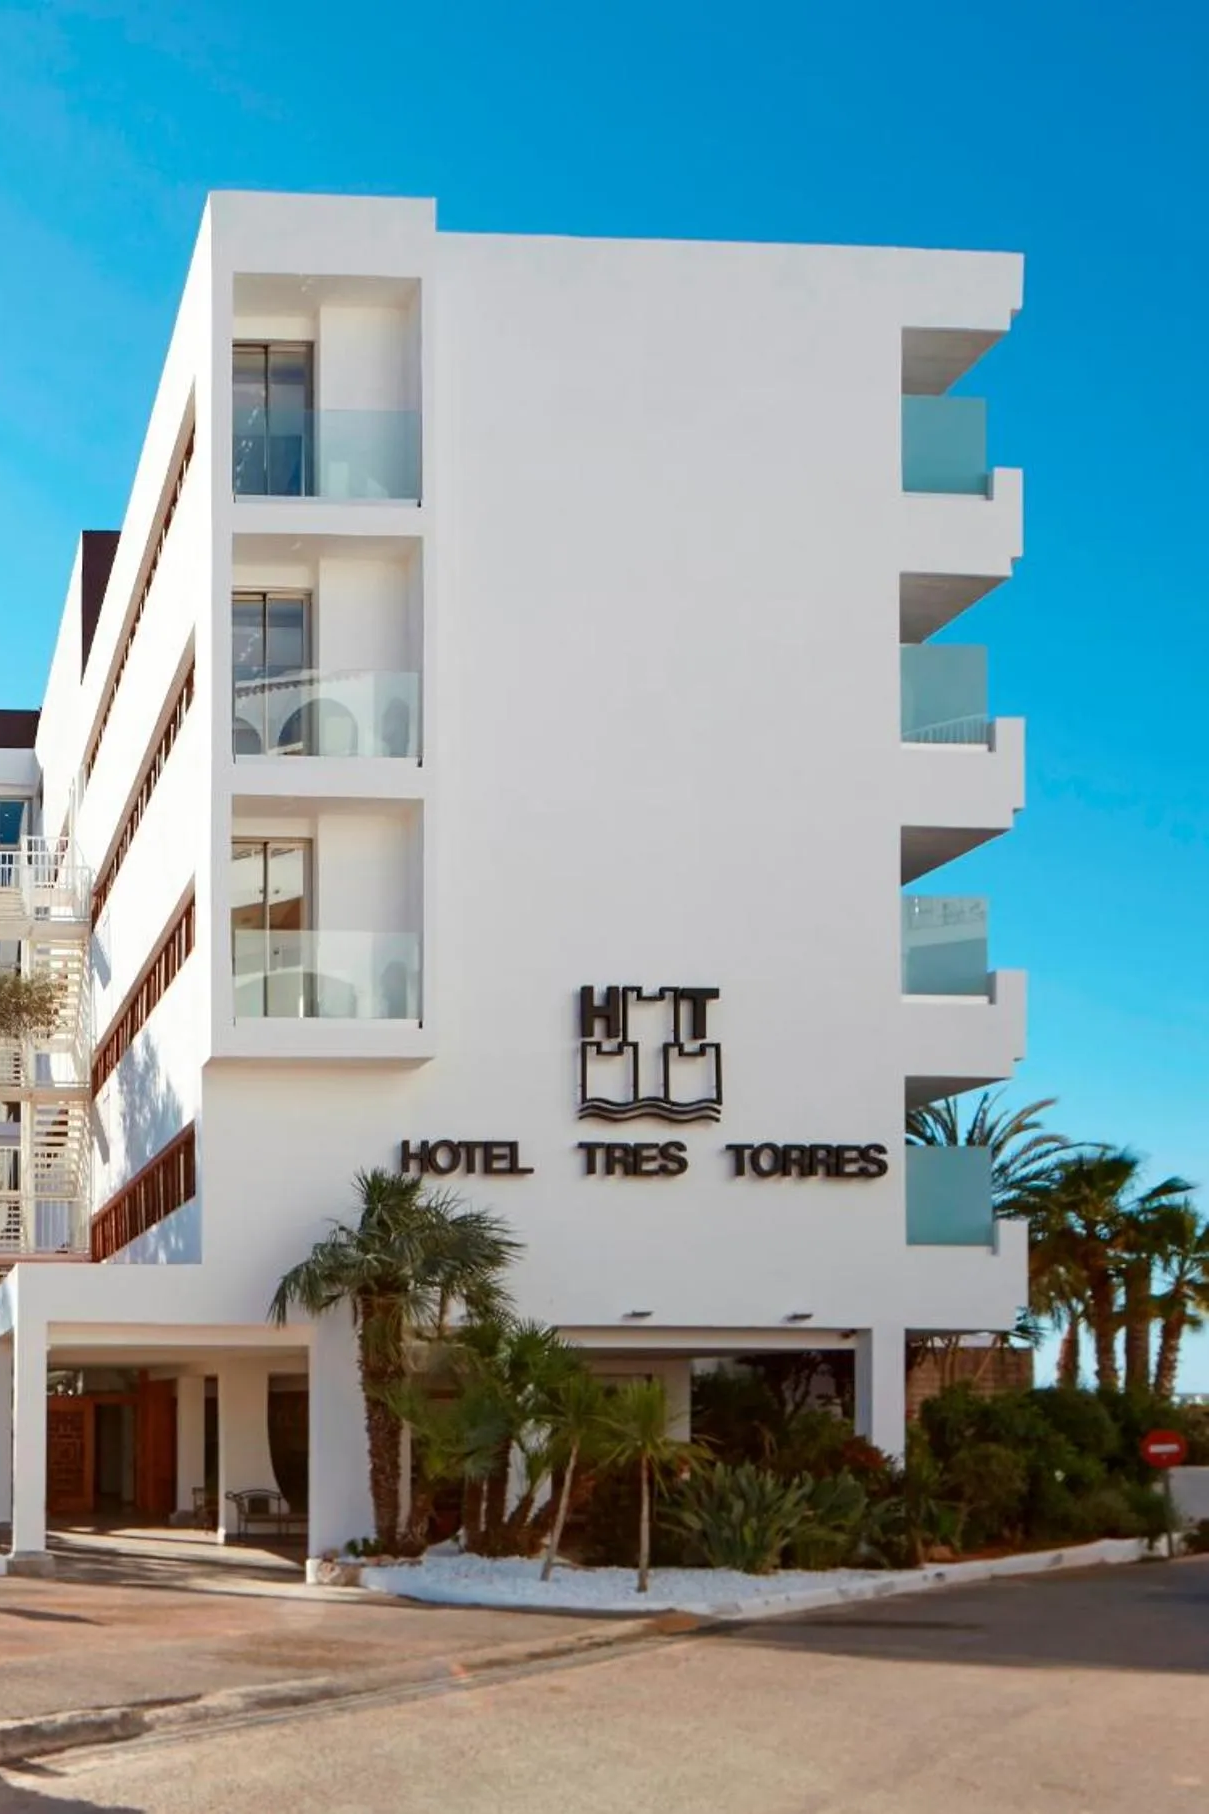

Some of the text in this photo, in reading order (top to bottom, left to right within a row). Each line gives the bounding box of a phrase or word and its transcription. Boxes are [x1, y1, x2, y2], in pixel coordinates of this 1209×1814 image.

[400, 1139, 889, 1178] HOTEL TRES TORRES
